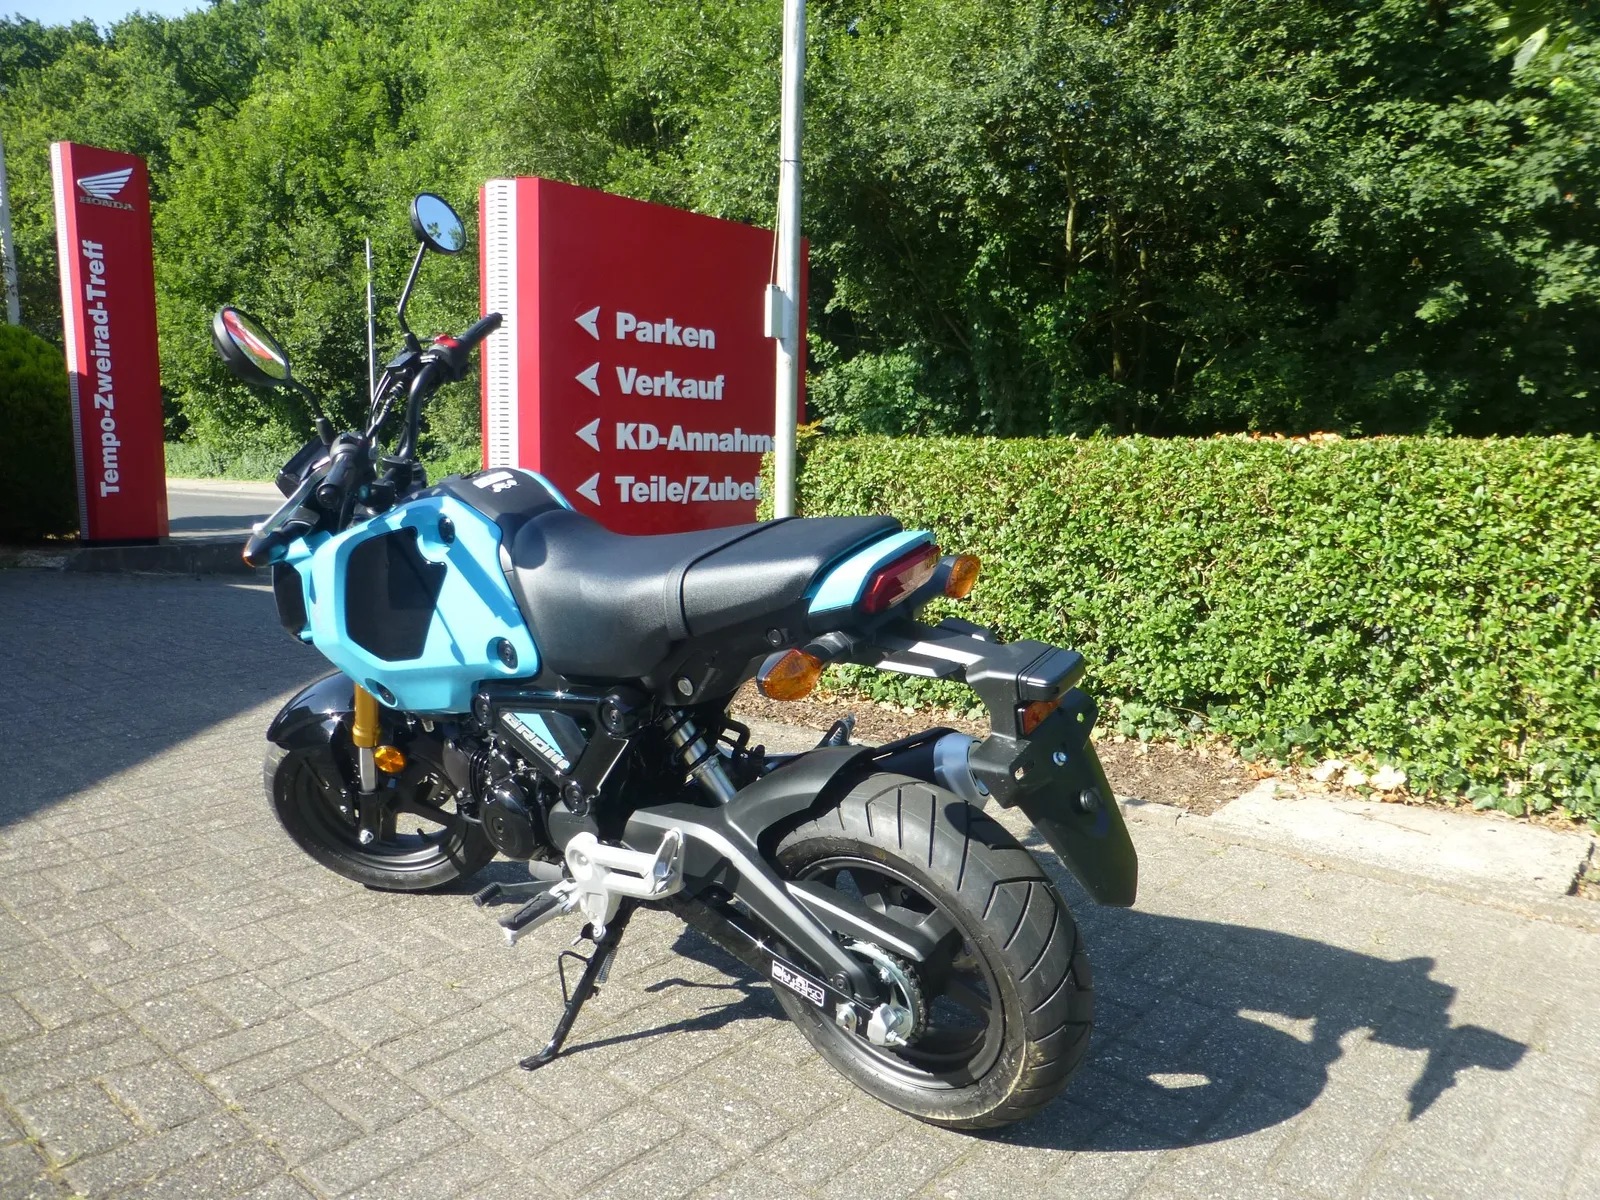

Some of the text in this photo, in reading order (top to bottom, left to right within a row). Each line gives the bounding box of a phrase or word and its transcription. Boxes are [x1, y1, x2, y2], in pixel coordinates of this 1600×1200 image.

[79, 196, 135, 211] HONDA
[615, 311, 716, 350] Parken
[82, 239, 121, 498] Tempo-Zweirad-Treff
[615, 366, 725, 401] Verkauf
[615, 422, 776, 453] KD-Annahm
